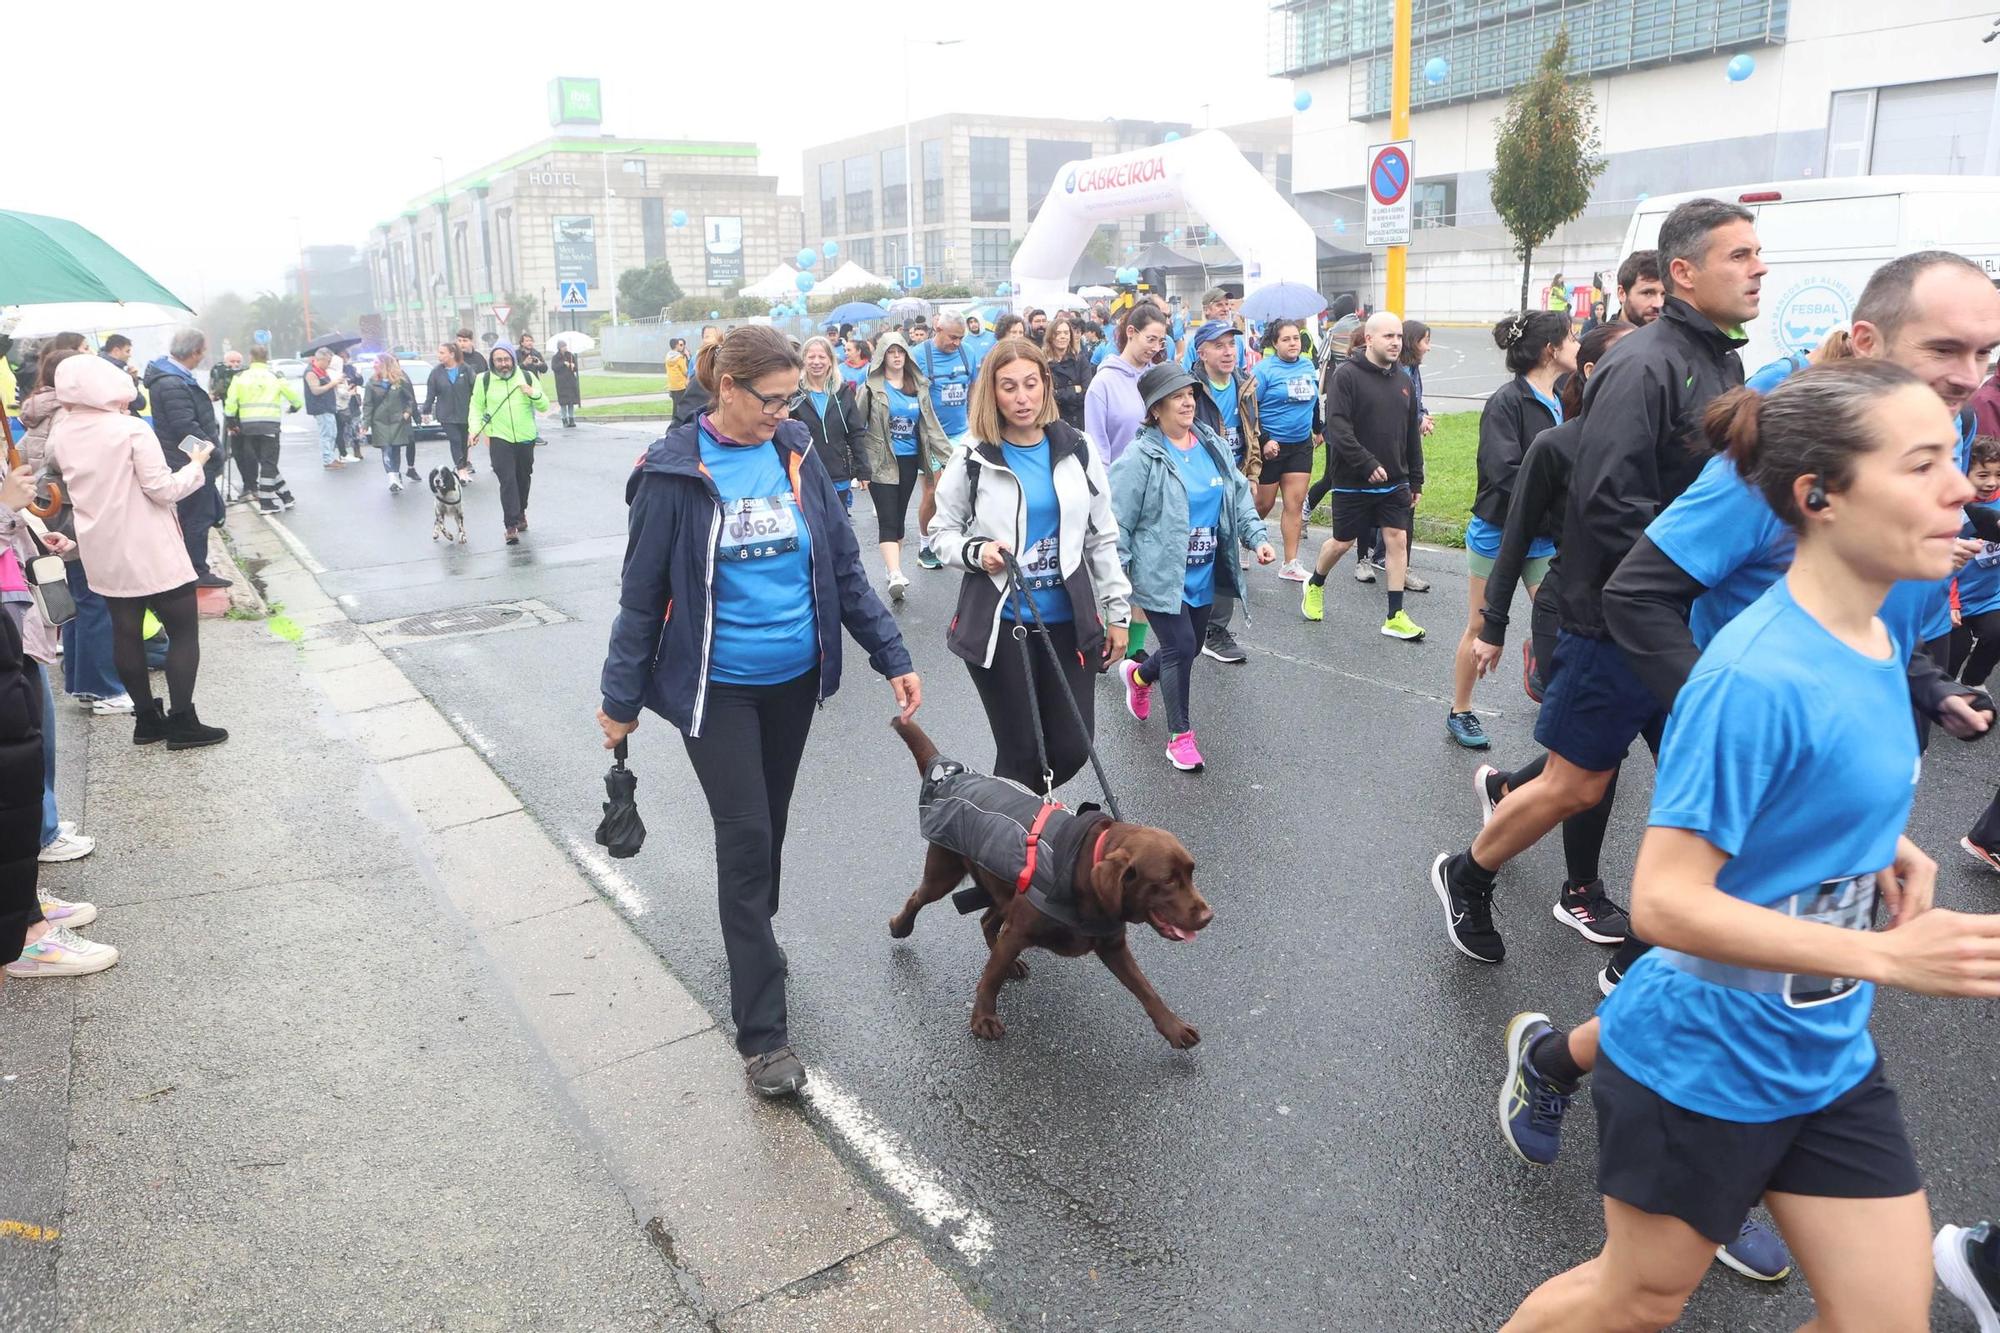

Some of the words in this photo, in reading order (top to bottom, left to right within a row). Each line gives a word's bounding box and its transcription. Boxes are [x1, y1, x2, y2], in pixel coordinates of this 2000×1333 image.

[529, 172, 581, 185] HOTEL
[907, 269, 918, 285] P
[1792, 304, 1838, 314] FESBAL
[729, 518, 780, 539] 0962
